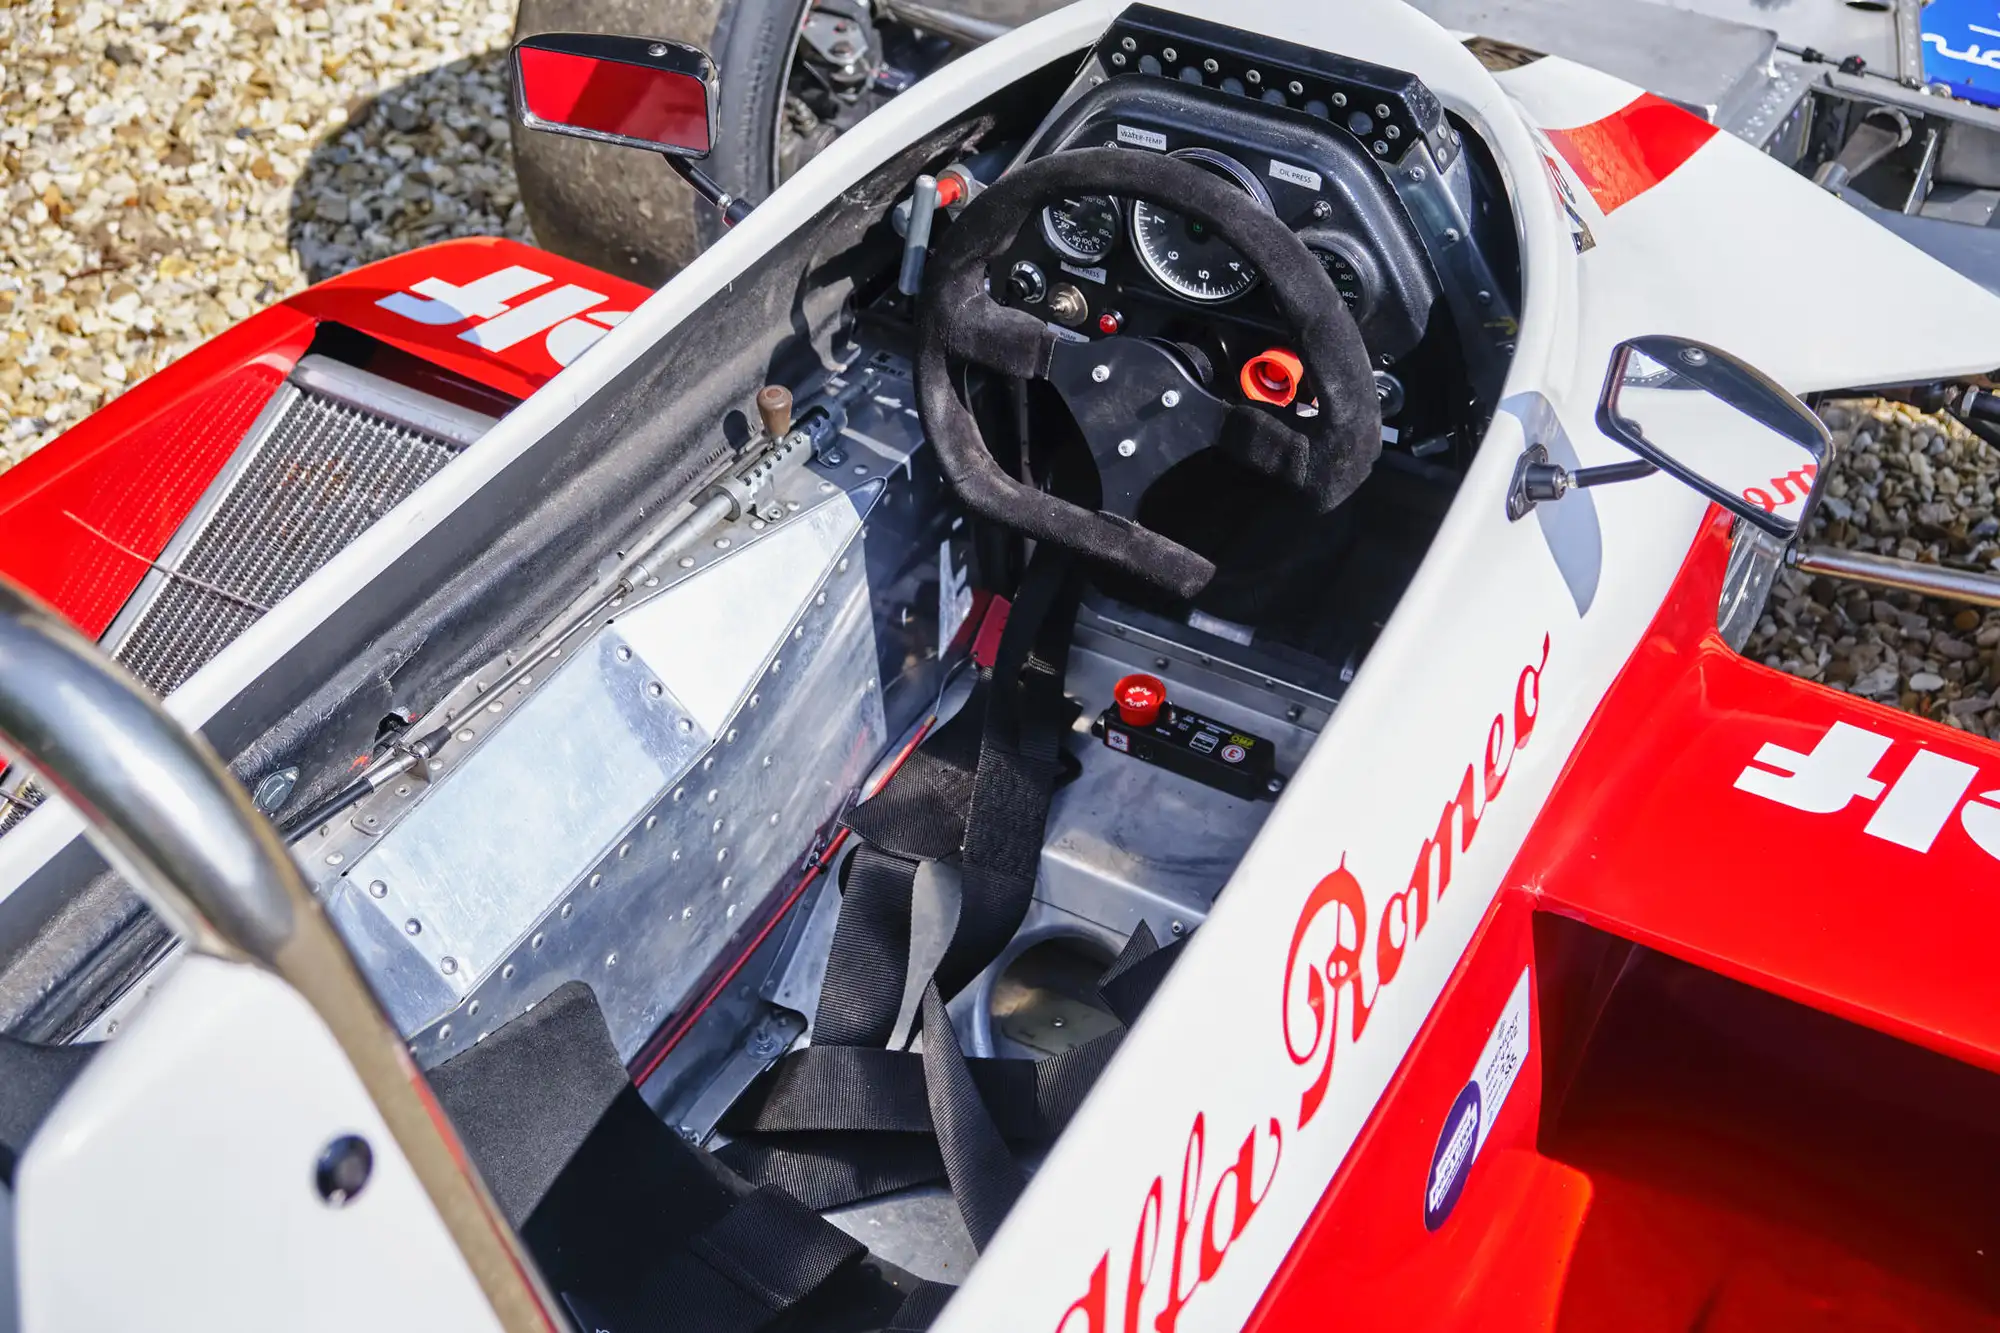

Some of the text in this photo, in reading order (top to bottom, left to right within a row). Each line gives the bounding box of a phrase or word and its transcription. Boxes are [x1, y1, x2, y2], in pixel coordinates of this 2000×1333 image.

[1279, 167, 1312, 184] OIL PRESS
[1154, 215, 1165, 224] 7
[1168, 251, 1179, 260] 6
[1229, 261, 1240, 272] 4
[1198, 269, 1210, 280] 5
[1733, 720, 2000, 862] lf
[1283, 631, 1550, 1132] Romeo
